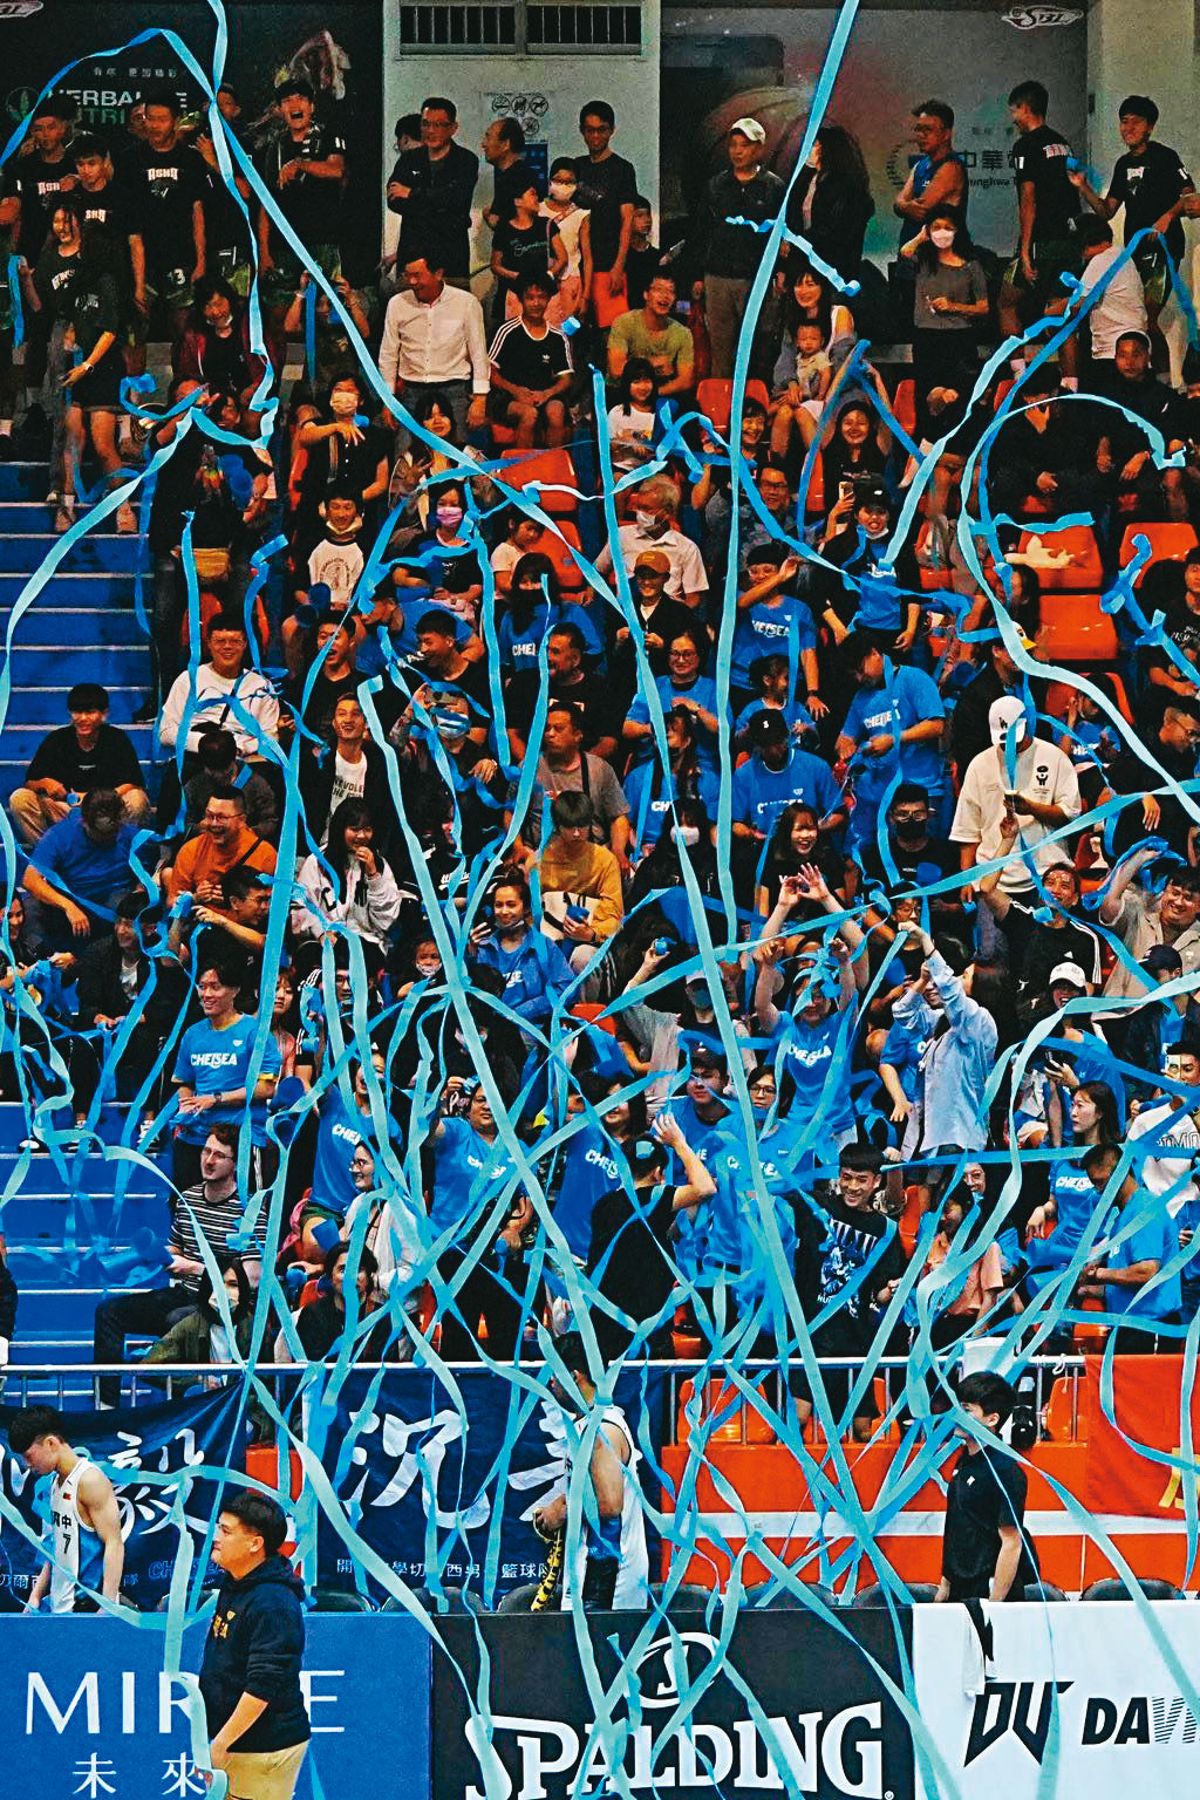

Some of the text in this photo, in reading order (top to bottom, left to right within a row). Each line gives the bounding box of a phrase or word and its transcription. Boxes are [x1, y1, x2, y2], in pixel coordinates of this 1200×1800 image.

[190, 1052, 238, 1069] CHELSEA
[25, 1670, 345, 1735] MIRE
[464, 1701, 884, 1800] SPALDING
